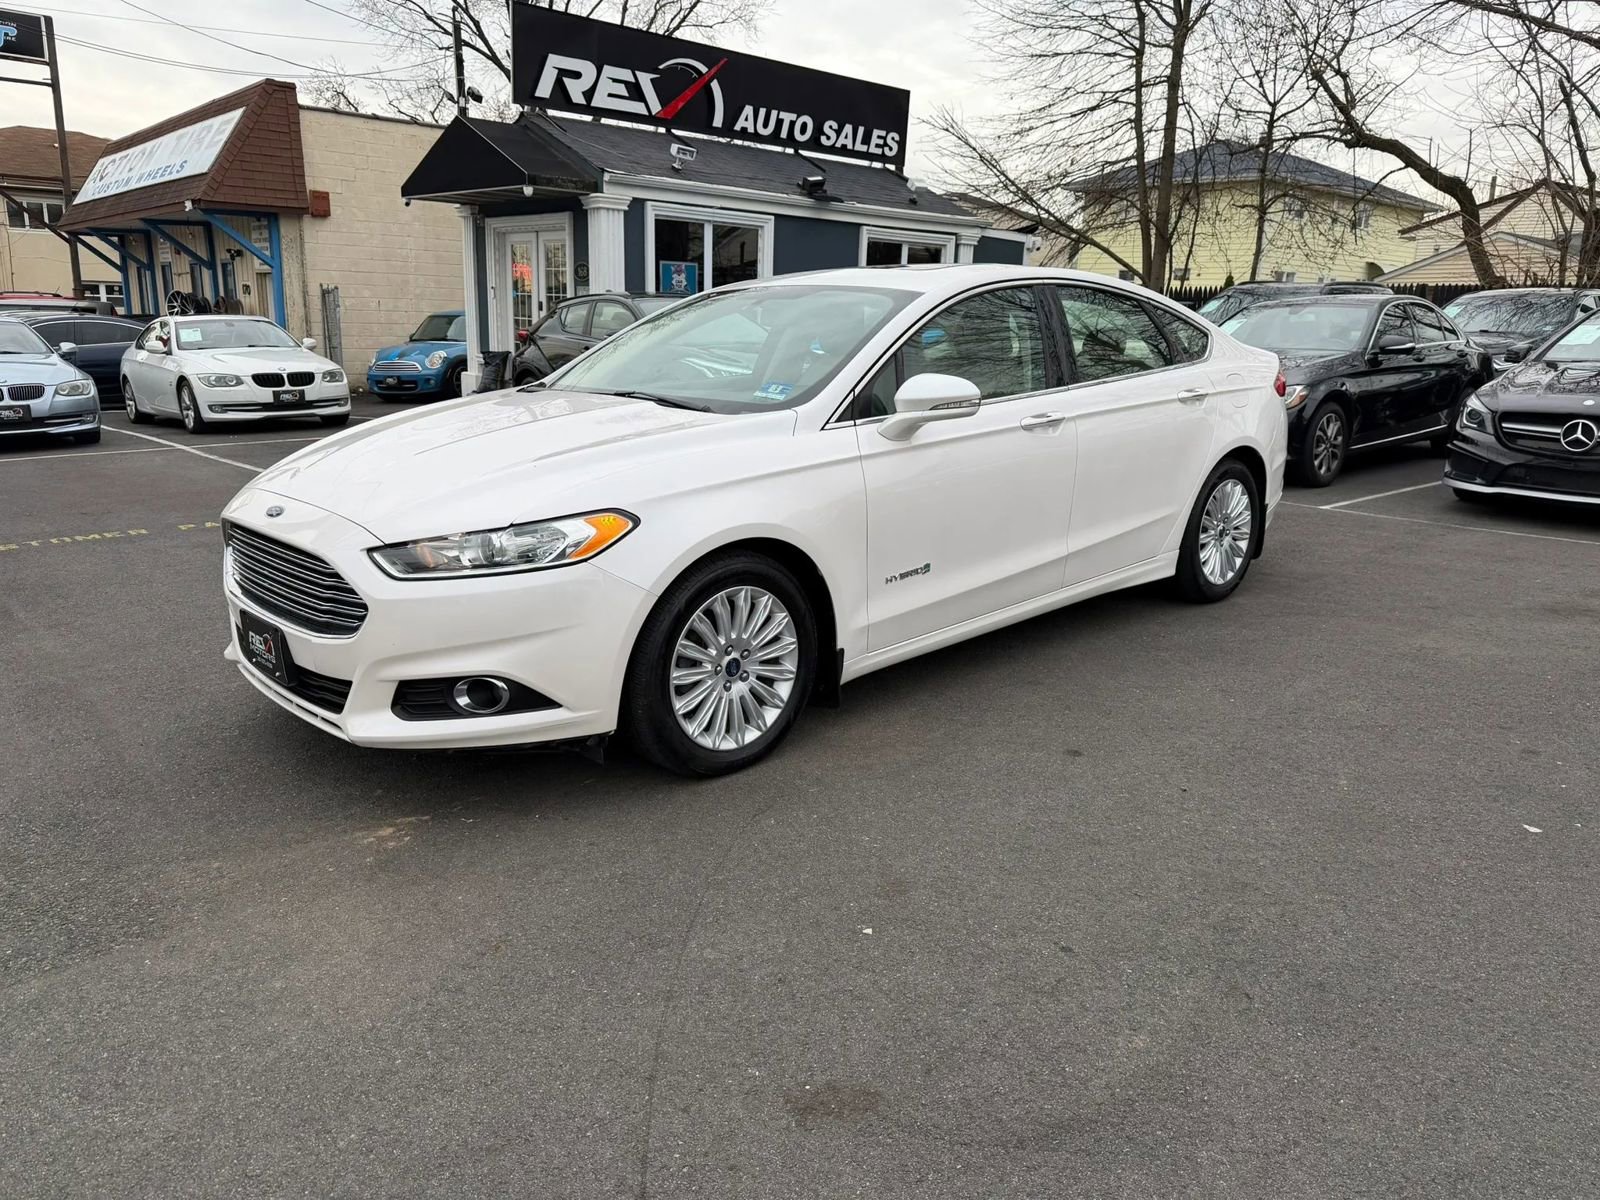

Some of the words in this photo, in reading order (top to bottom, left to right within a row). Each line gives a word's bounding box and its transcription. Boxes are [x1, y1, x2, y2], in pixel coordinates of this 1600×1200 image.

[534, 53, 728, 128] REV
[733, 104, 813, 142] AUTO
[819, 119, 900, 157] SALES
[91, 175, 133, 197] CUSTOM
[135, 159, 188, 185] WHEELS
